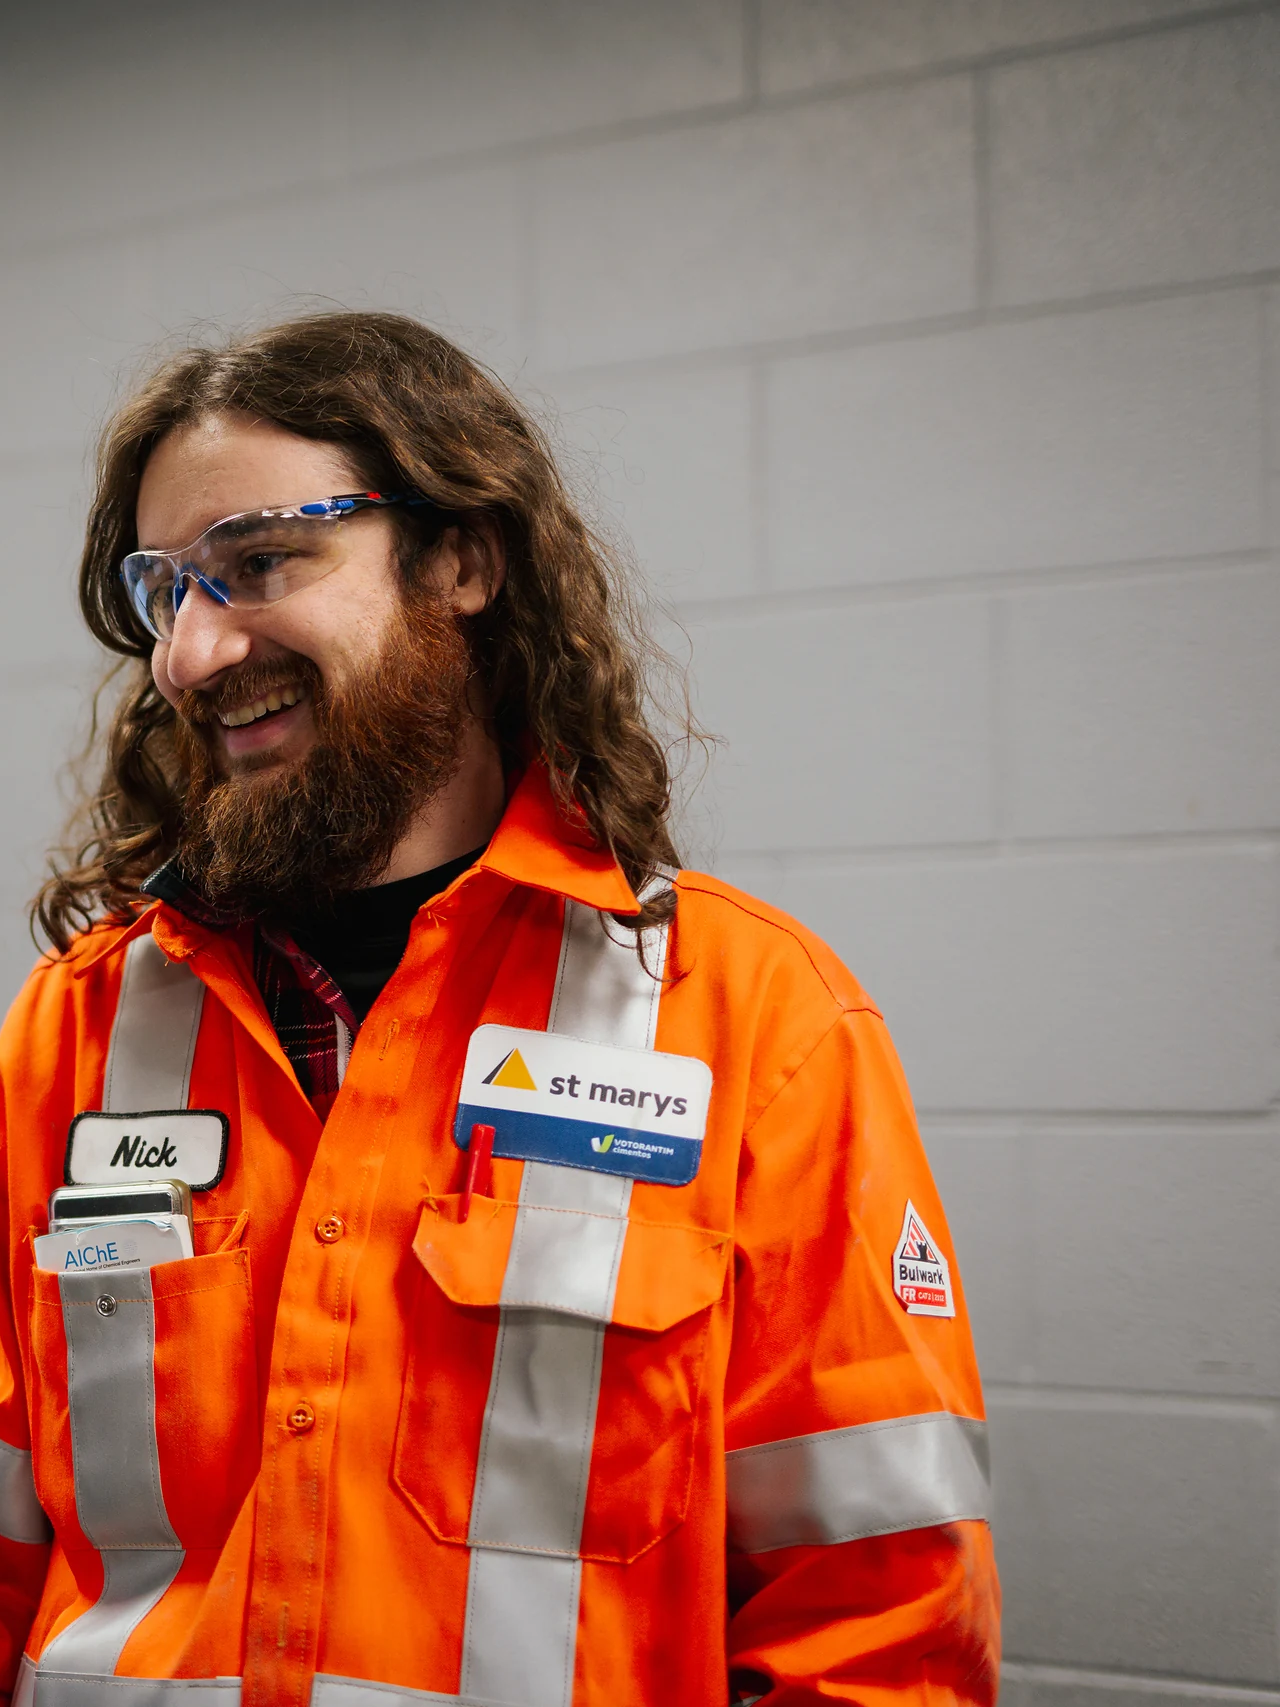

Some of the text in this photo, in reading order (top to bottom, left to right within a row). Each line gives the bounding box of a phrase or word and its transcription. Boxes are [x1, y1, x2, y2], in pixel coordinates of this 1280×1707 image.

[549, 1074, 688, 1118] st marys
[109, 1135, 178, 1168] Nick
[612, 1146, 652, 1159] cimentos
[614, 1138, 675, 1156] VOTORANTIM
[64, 1241, 119, 1269] AIChE
[103, 1261, 121, 1269] Chemical
[899, 1264, 944, 1285] Bulwark
[902, 1287, 917, 1302] FR
